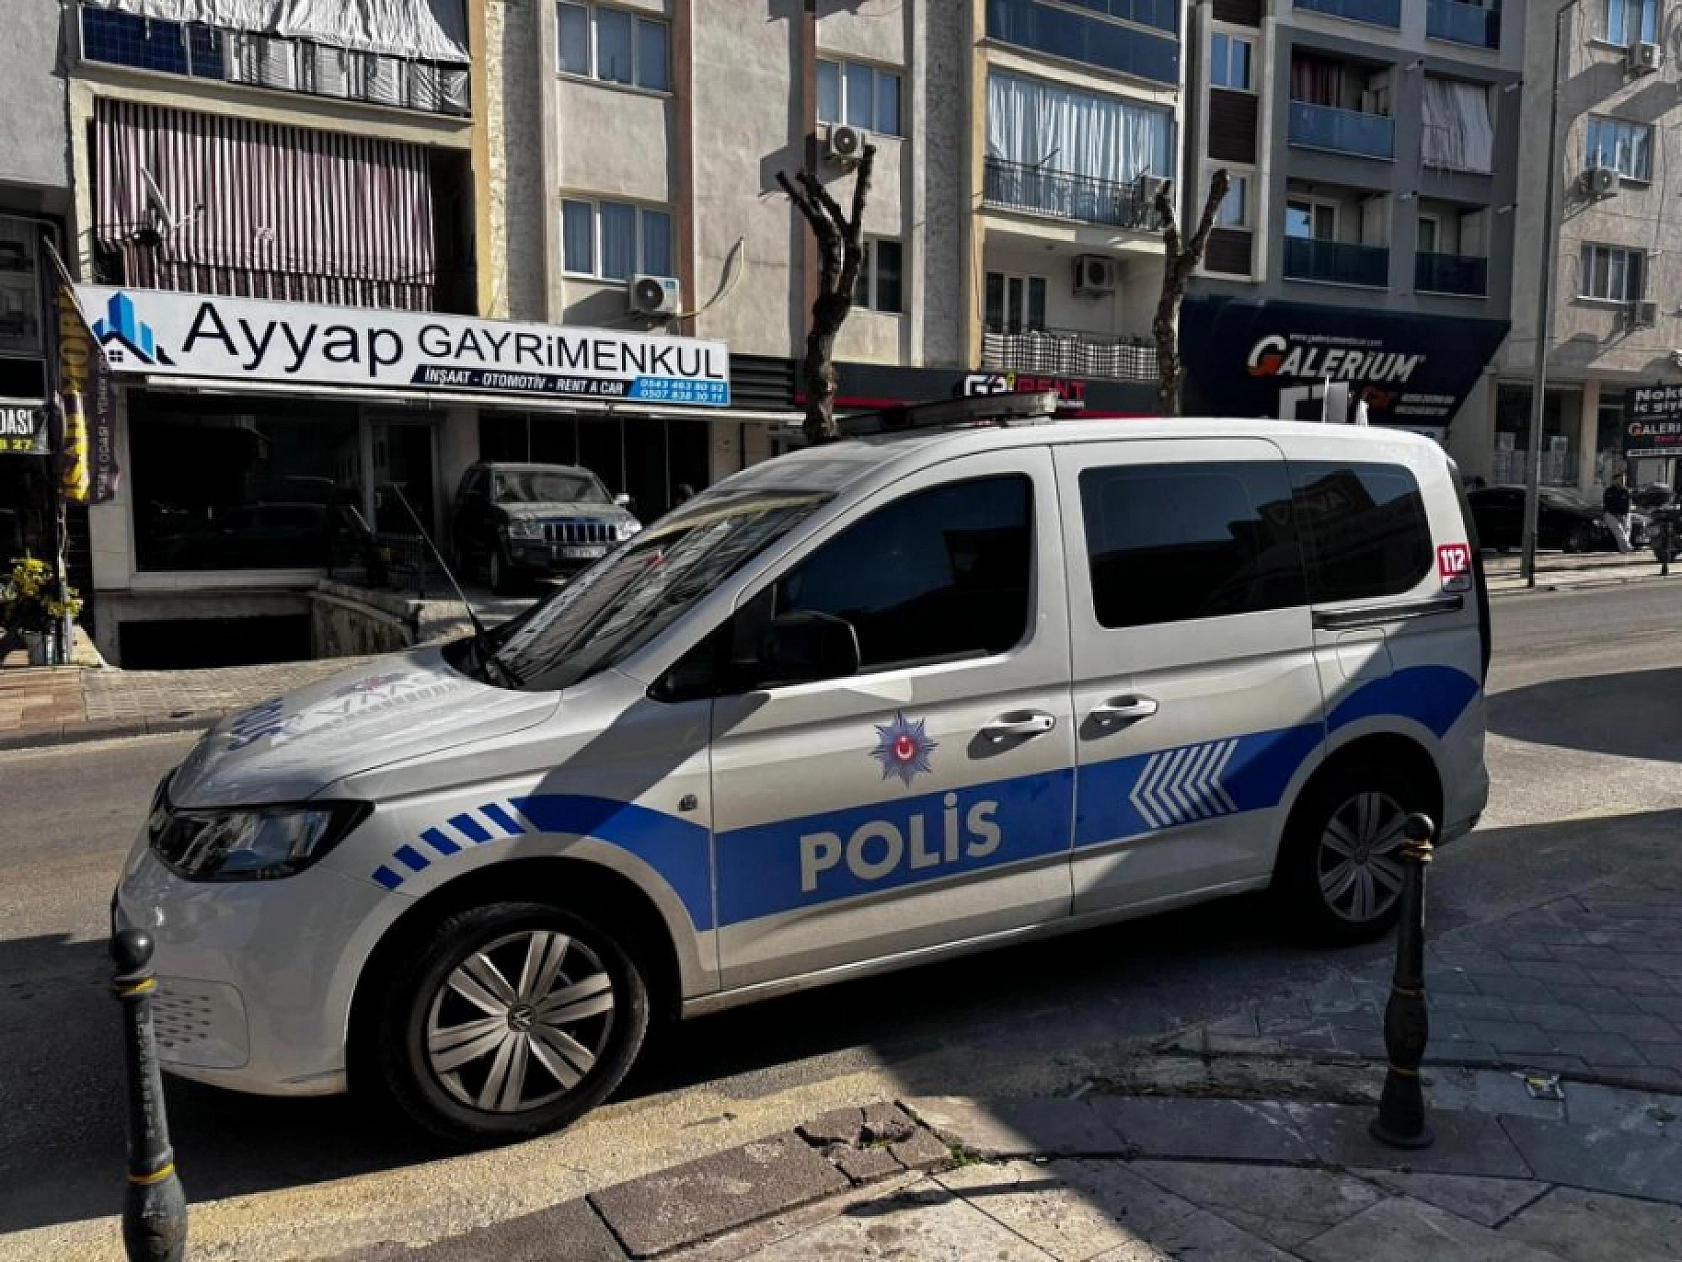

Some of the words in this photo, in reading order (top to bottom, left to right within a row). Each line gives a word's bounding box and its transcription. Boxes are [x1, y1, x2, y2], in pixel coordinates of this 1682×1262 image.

[181, 301, 404, 378] Ayyap
[556, 378, 588, 391] RENT
[589, 380, 599, 393] A
[601, 381, 623, 395] CAR
[1440, 549, 1466, 572] 112
